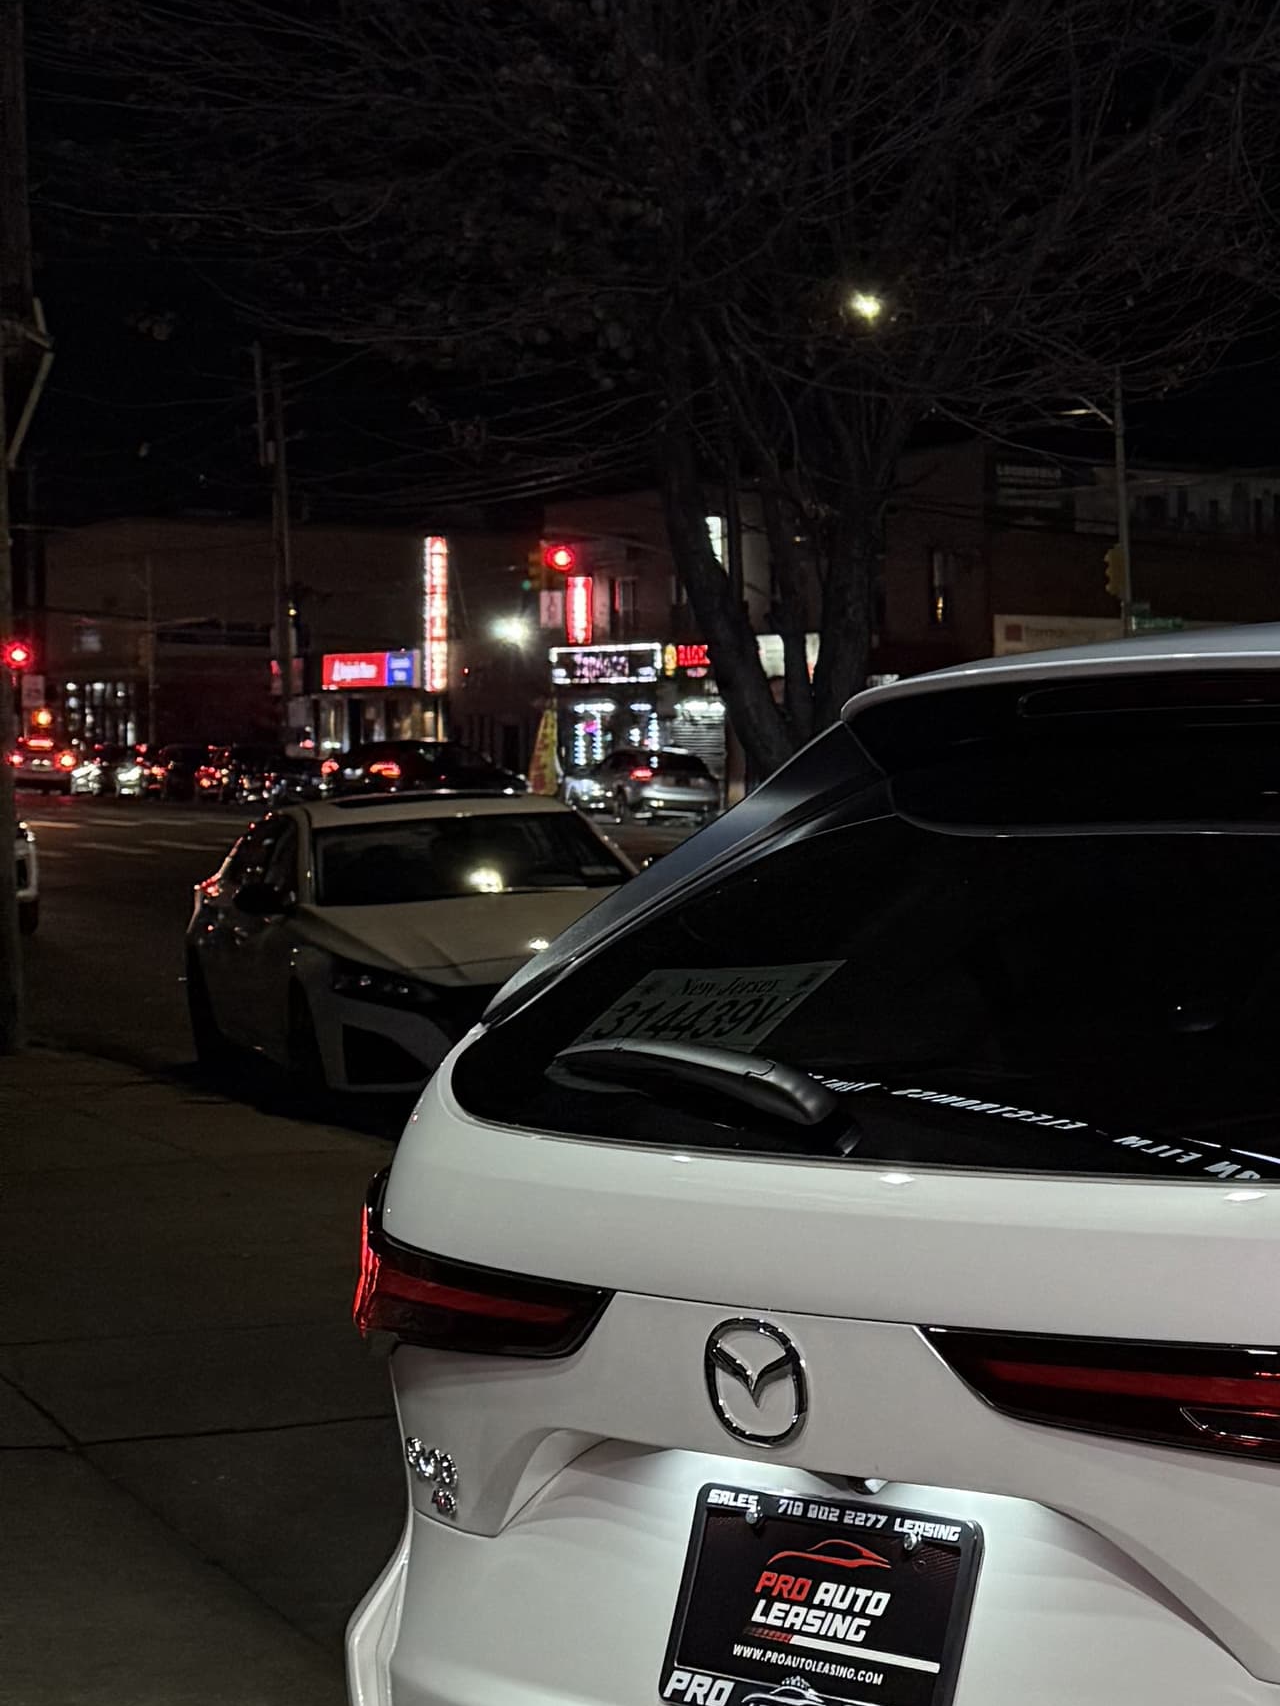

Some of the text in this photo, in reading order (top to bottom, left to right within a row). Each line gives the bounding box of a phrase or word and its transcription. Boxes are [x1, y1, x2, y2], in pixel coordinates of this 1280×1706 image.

[707, 1489, 759, 1512] SALES
[894, 1517, 962, 1542] LEASING
[755, 1571, 892, 1616] PRO AUTO
[751, 1598, 872, 1643] LEASING
[732, 1643, 884, 1685] WWW.PROAUTOLEASING.COM
